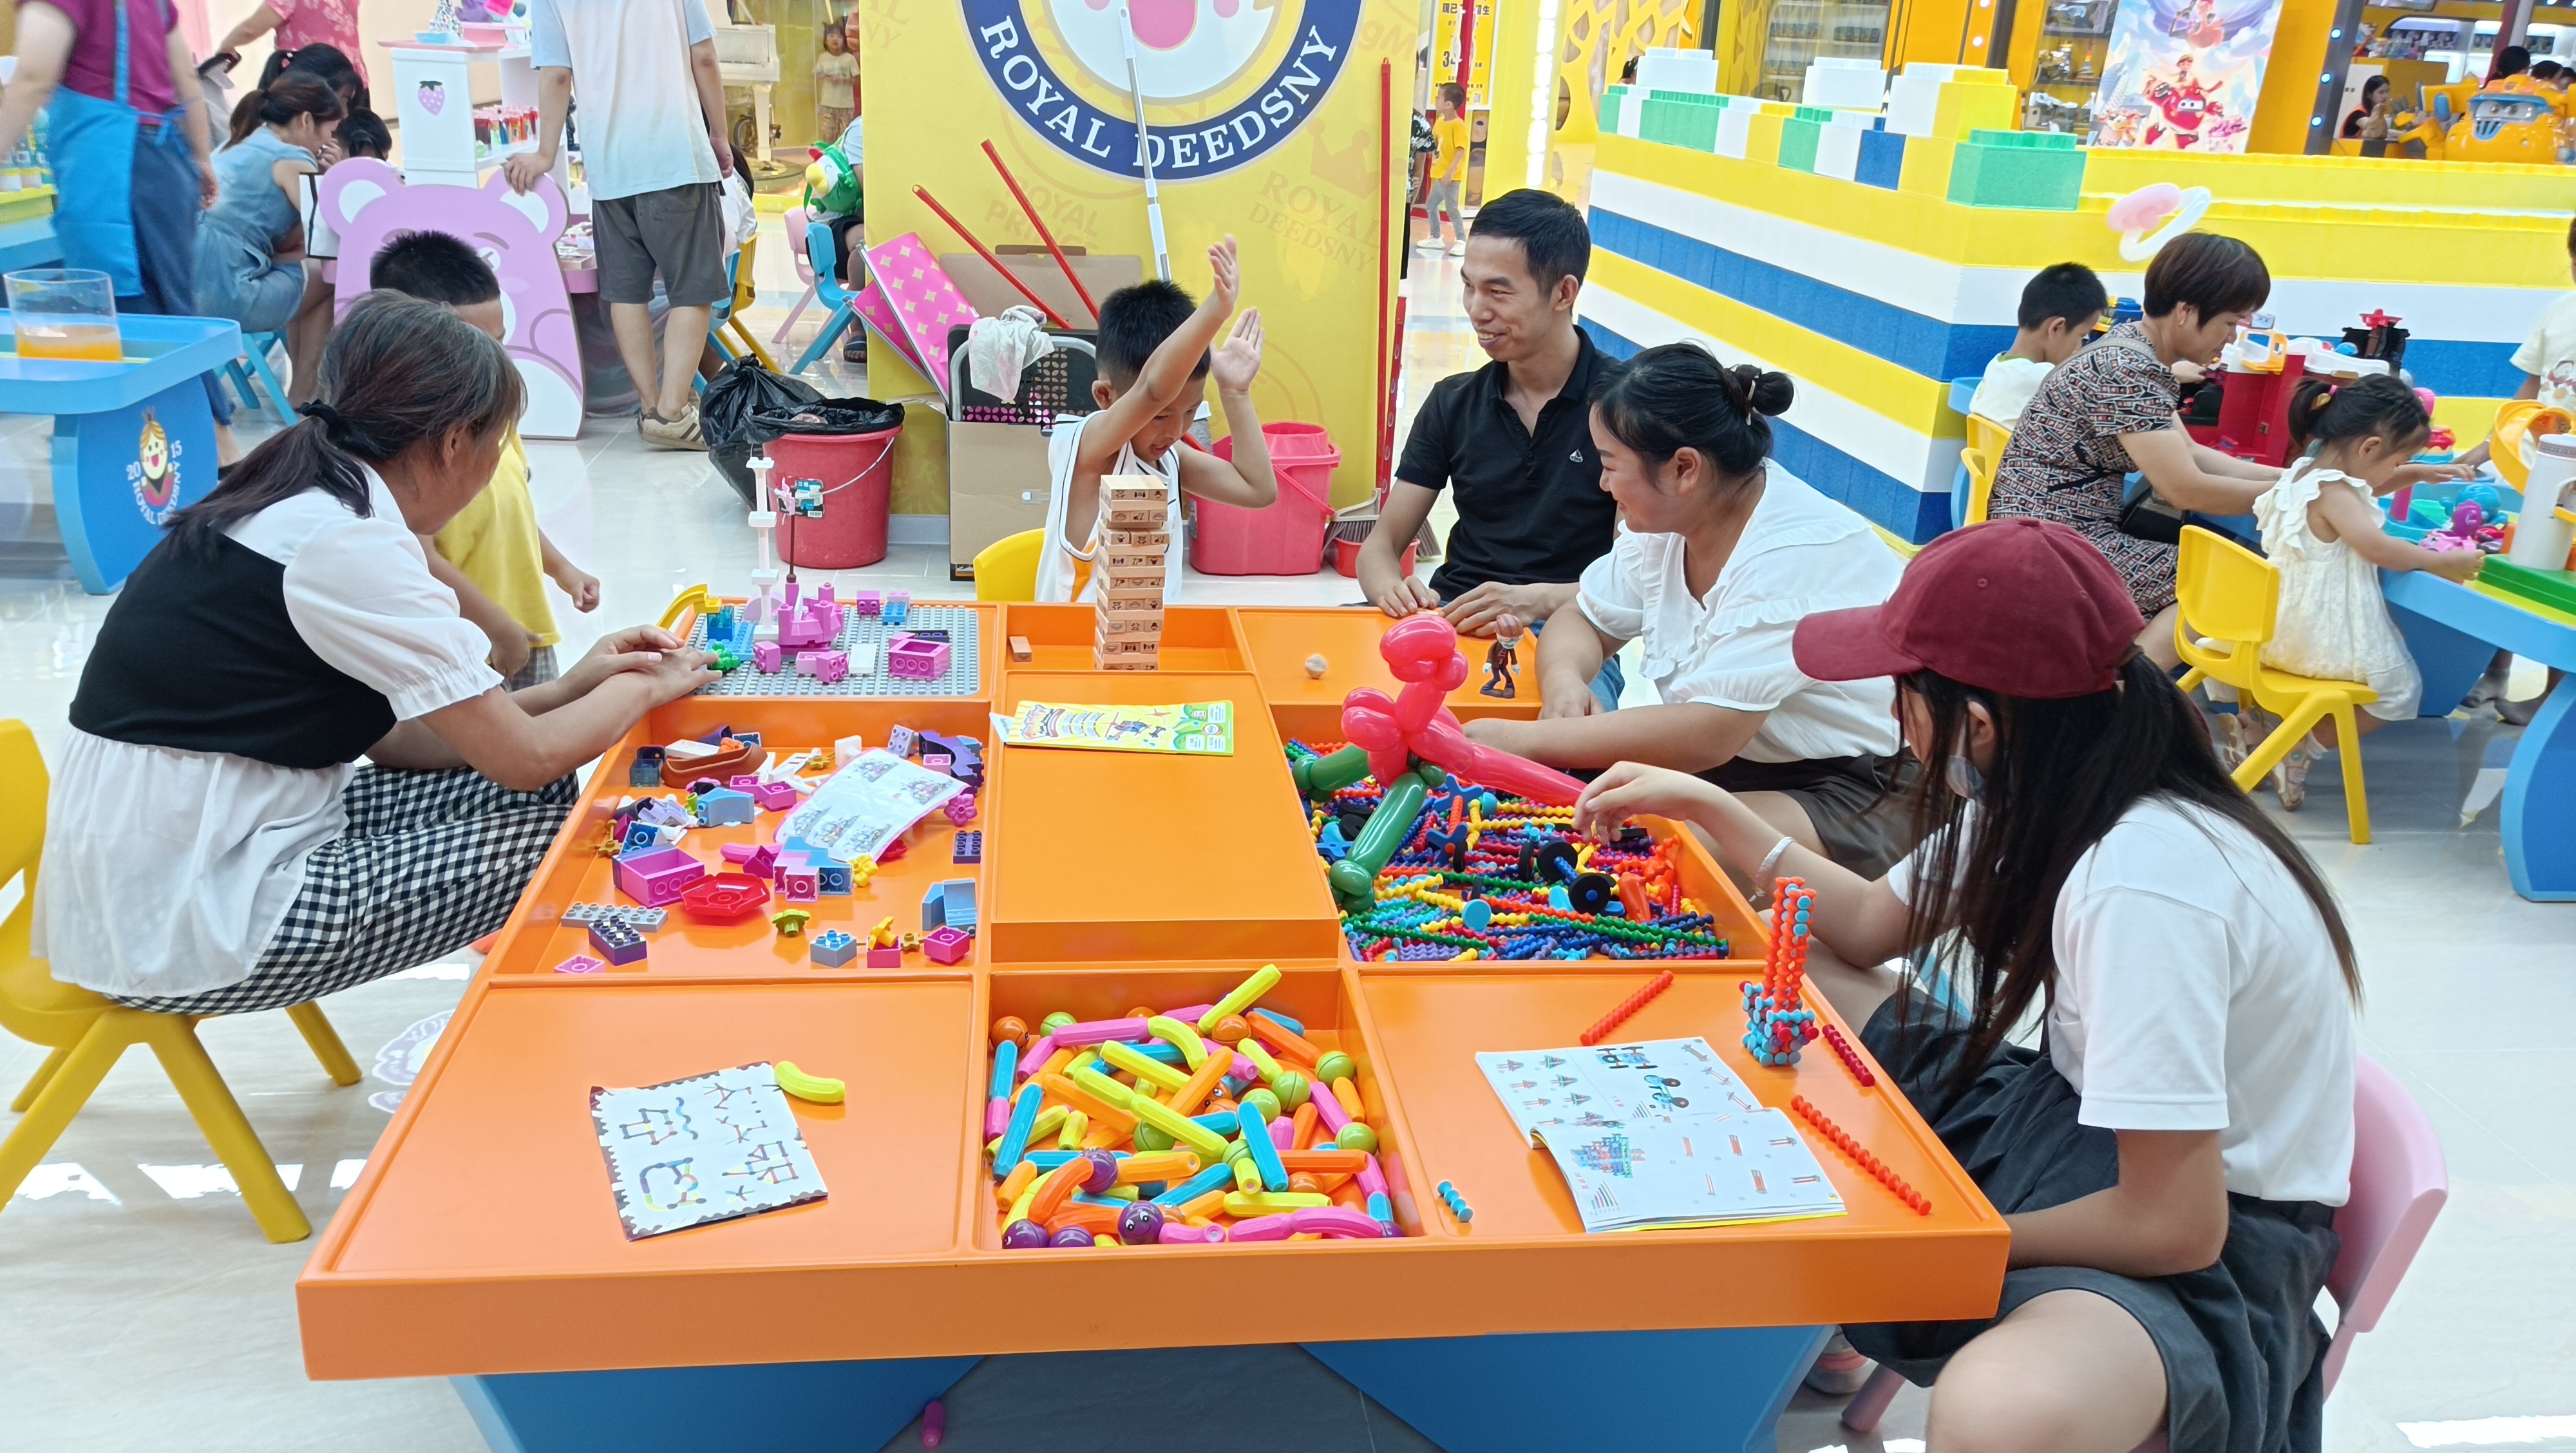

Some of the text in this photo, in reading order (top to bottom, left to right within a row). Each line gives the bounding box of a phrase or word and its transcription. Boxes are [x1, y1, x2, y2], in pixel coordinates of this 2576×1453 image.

[980, 15, 1337, 169] ROYAL DEEDSNY
[1248, 202, 1376, 272] DEEDSNY
[1260, 169, 1380, 249] ROYAL
[126, 440, 182, 480] 20 15
